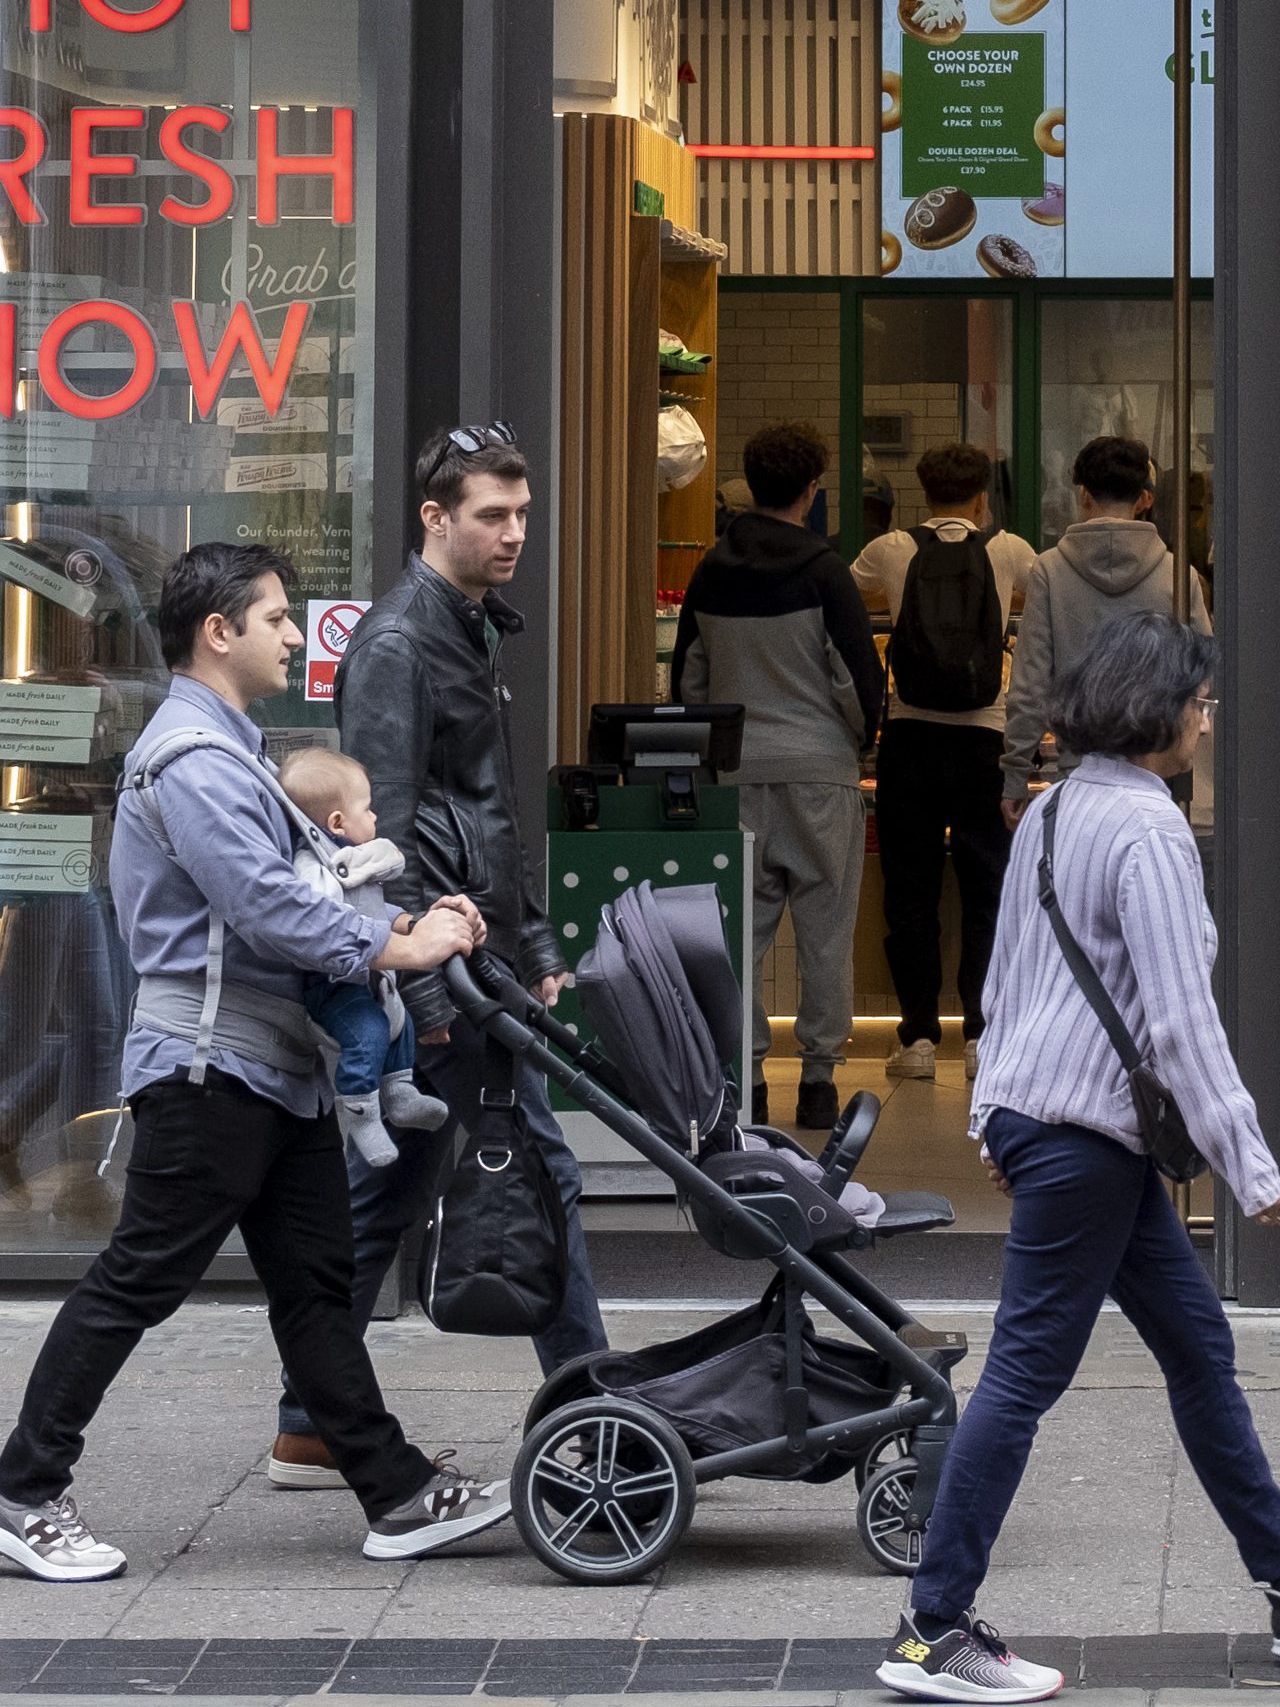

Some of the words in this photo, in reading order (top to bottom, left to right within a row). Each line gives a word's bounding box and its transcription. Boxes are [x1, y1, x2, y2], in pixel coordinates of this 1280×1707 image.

[927, 50, 981, 61] CHOOSE
[983, 50, 1019, 61] YOUR
[934, 63, 966, 74] OWN
[968, 63, 1012, 74] DOZEN
[942, 105, 949, 114] 6
[949, 105, 972, 114] PACK
[942, 119, 949, 127] 4
[949, 119, 973, 128] PACK
[928, 147, 963, 156] DOUBLE
[964, 147, 995, 156] DOZEN
[996, 147, 1019, 155] DEAL
[0, 300, 314, 420] OW
[236, 524, 263, 538] Our
[266, 524, 319, 539] founder,
[302, 544, 350, 562] wearing
[301, 566, 352, 574] summer
[300, 579, 339, 596] dough
[45, 693, 66, 701] DAILY
